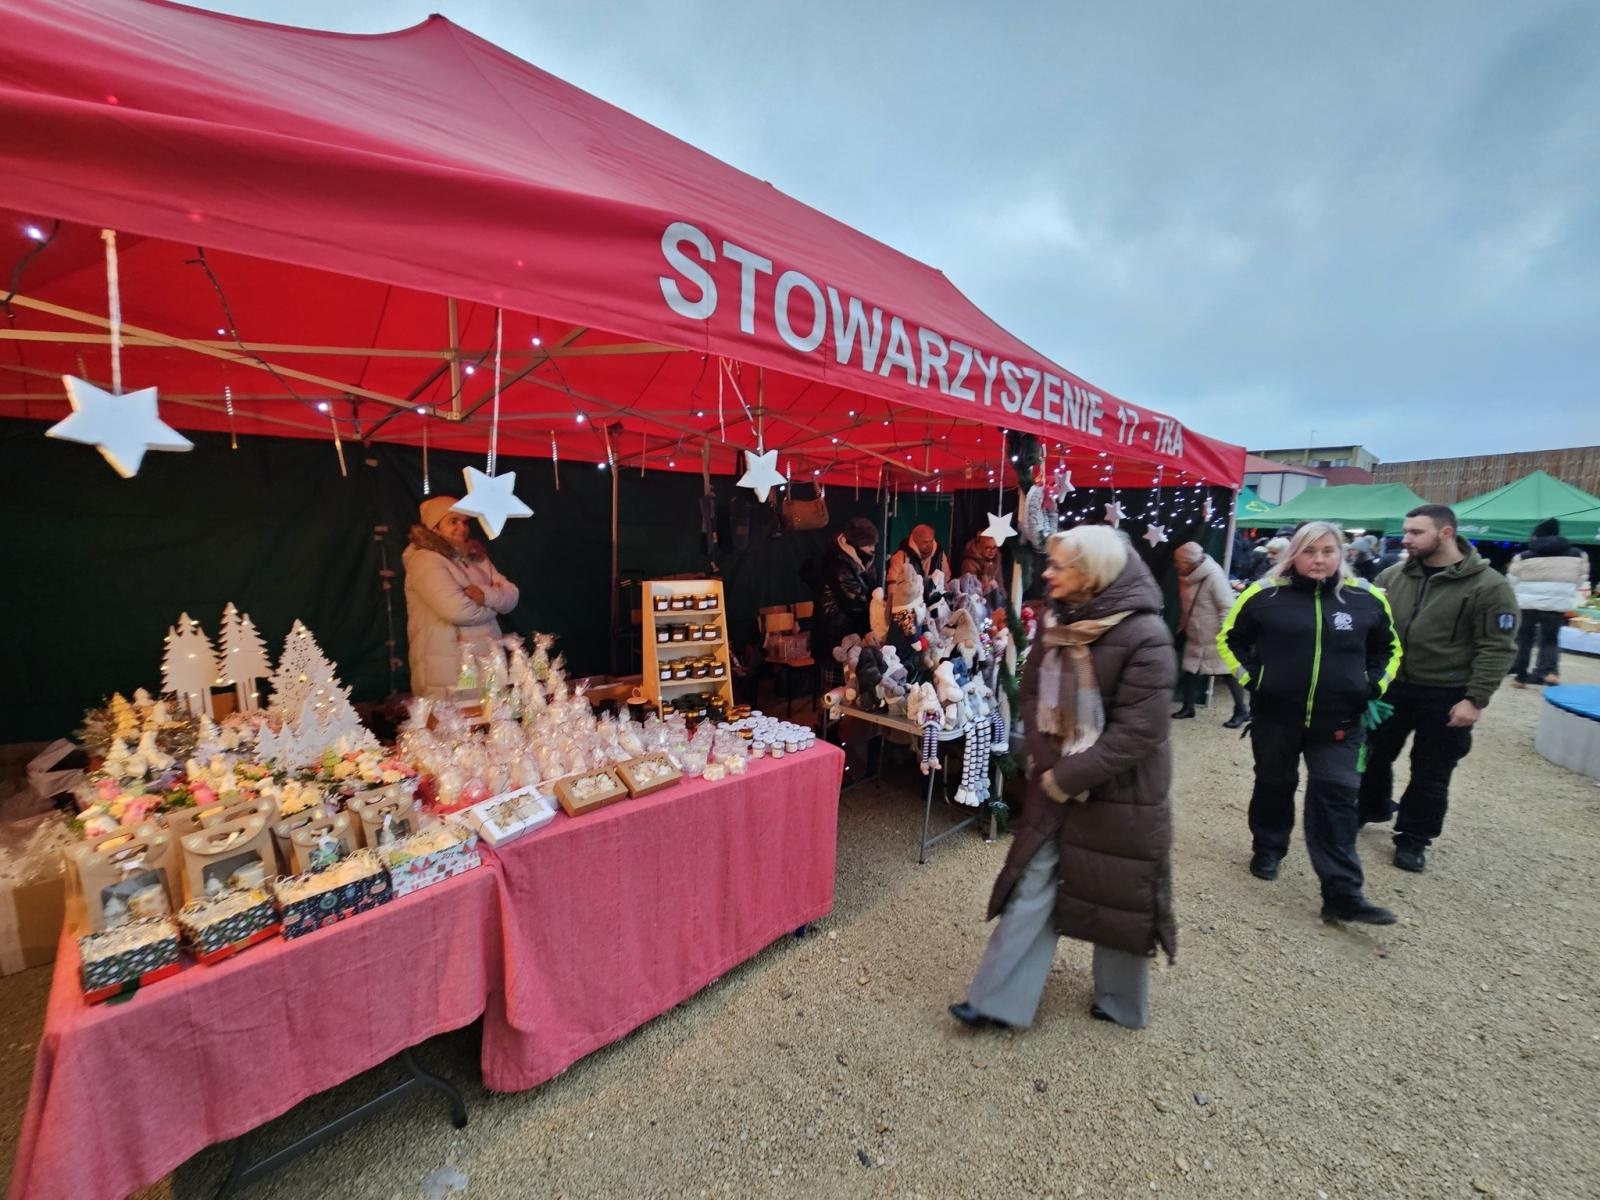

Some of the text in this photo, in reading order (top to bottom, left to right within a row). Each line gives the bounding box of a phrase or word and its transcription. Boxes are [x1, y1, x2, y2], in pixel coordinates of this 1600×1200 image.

[659, 222, 1104, 437] STOWARZYSZENIE
[1117, 405, 1140, 445] 17
[1152, 415, 1184, 458] TKA
